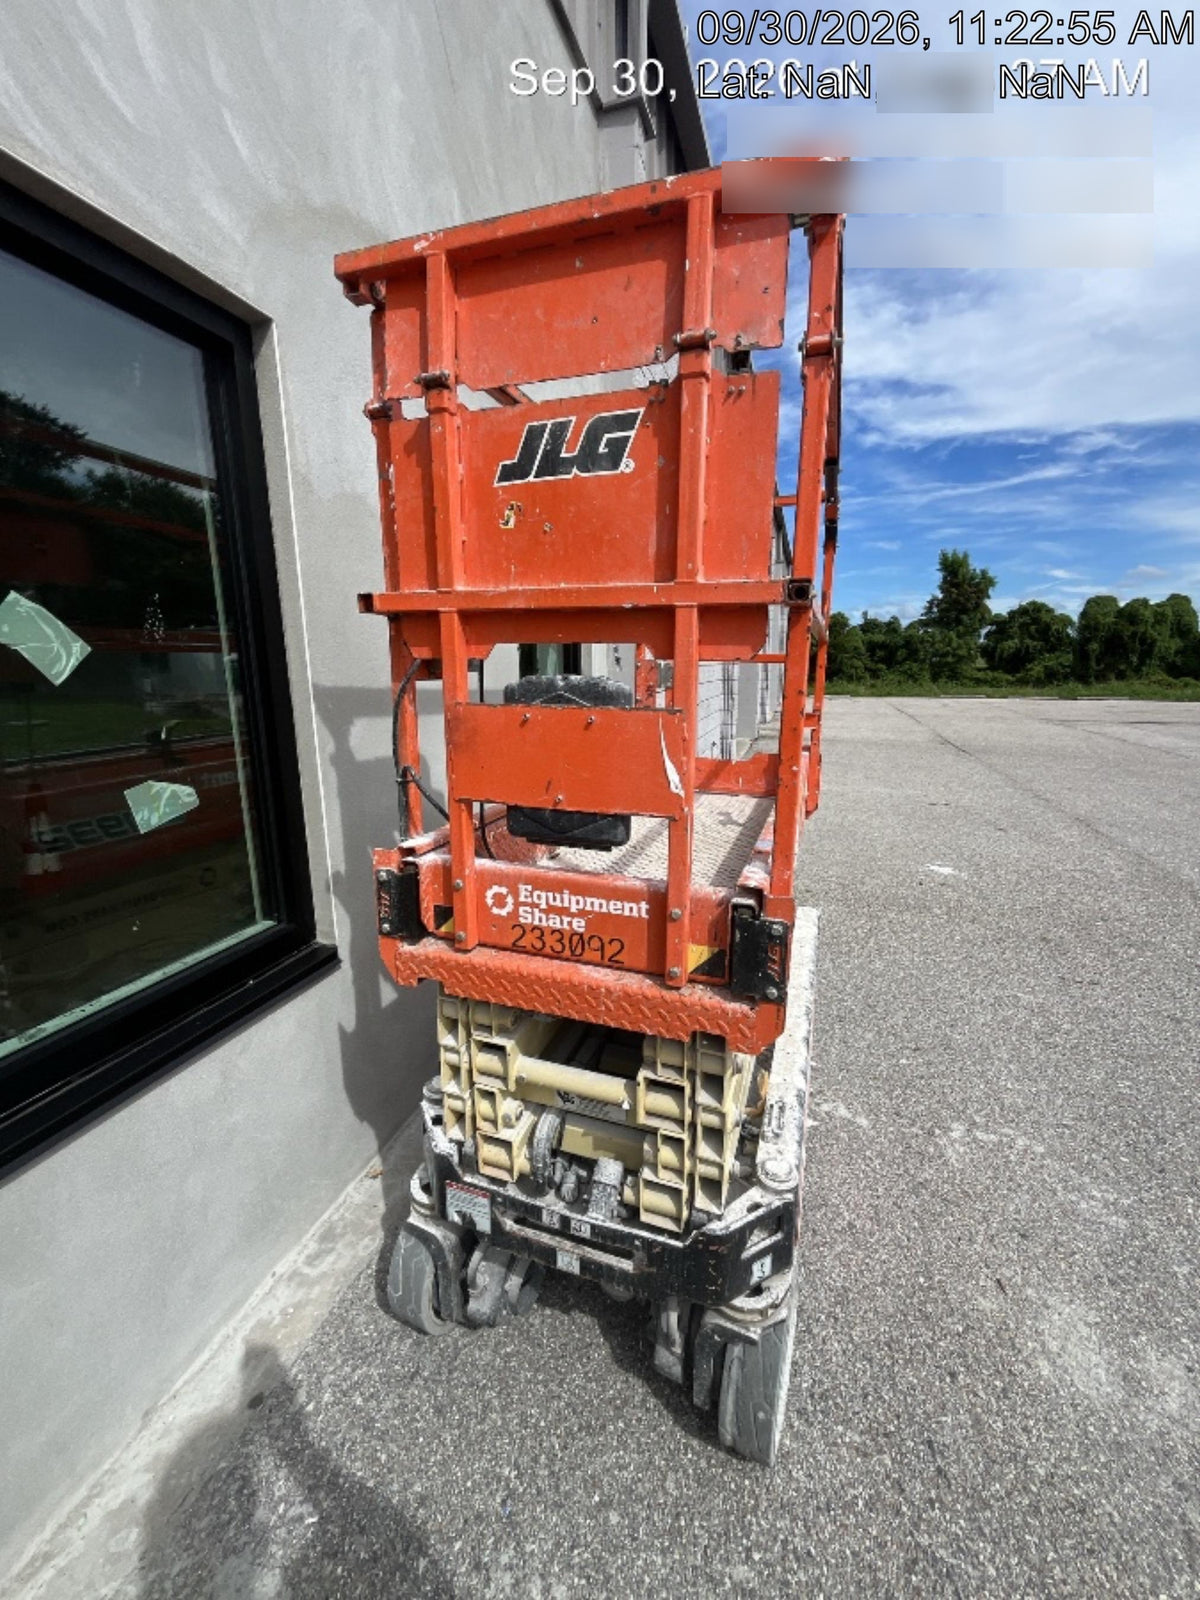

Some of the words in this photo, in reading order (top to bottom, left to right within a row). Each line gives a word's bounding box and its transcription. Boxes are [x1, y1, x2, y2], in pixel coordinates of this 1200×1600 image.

[493, 407, 646, 488] JLG
[517, 884, 650, 919] Equipment
[518, 906, 587, 933] Share
[511, 923, 625, 965] 233092
